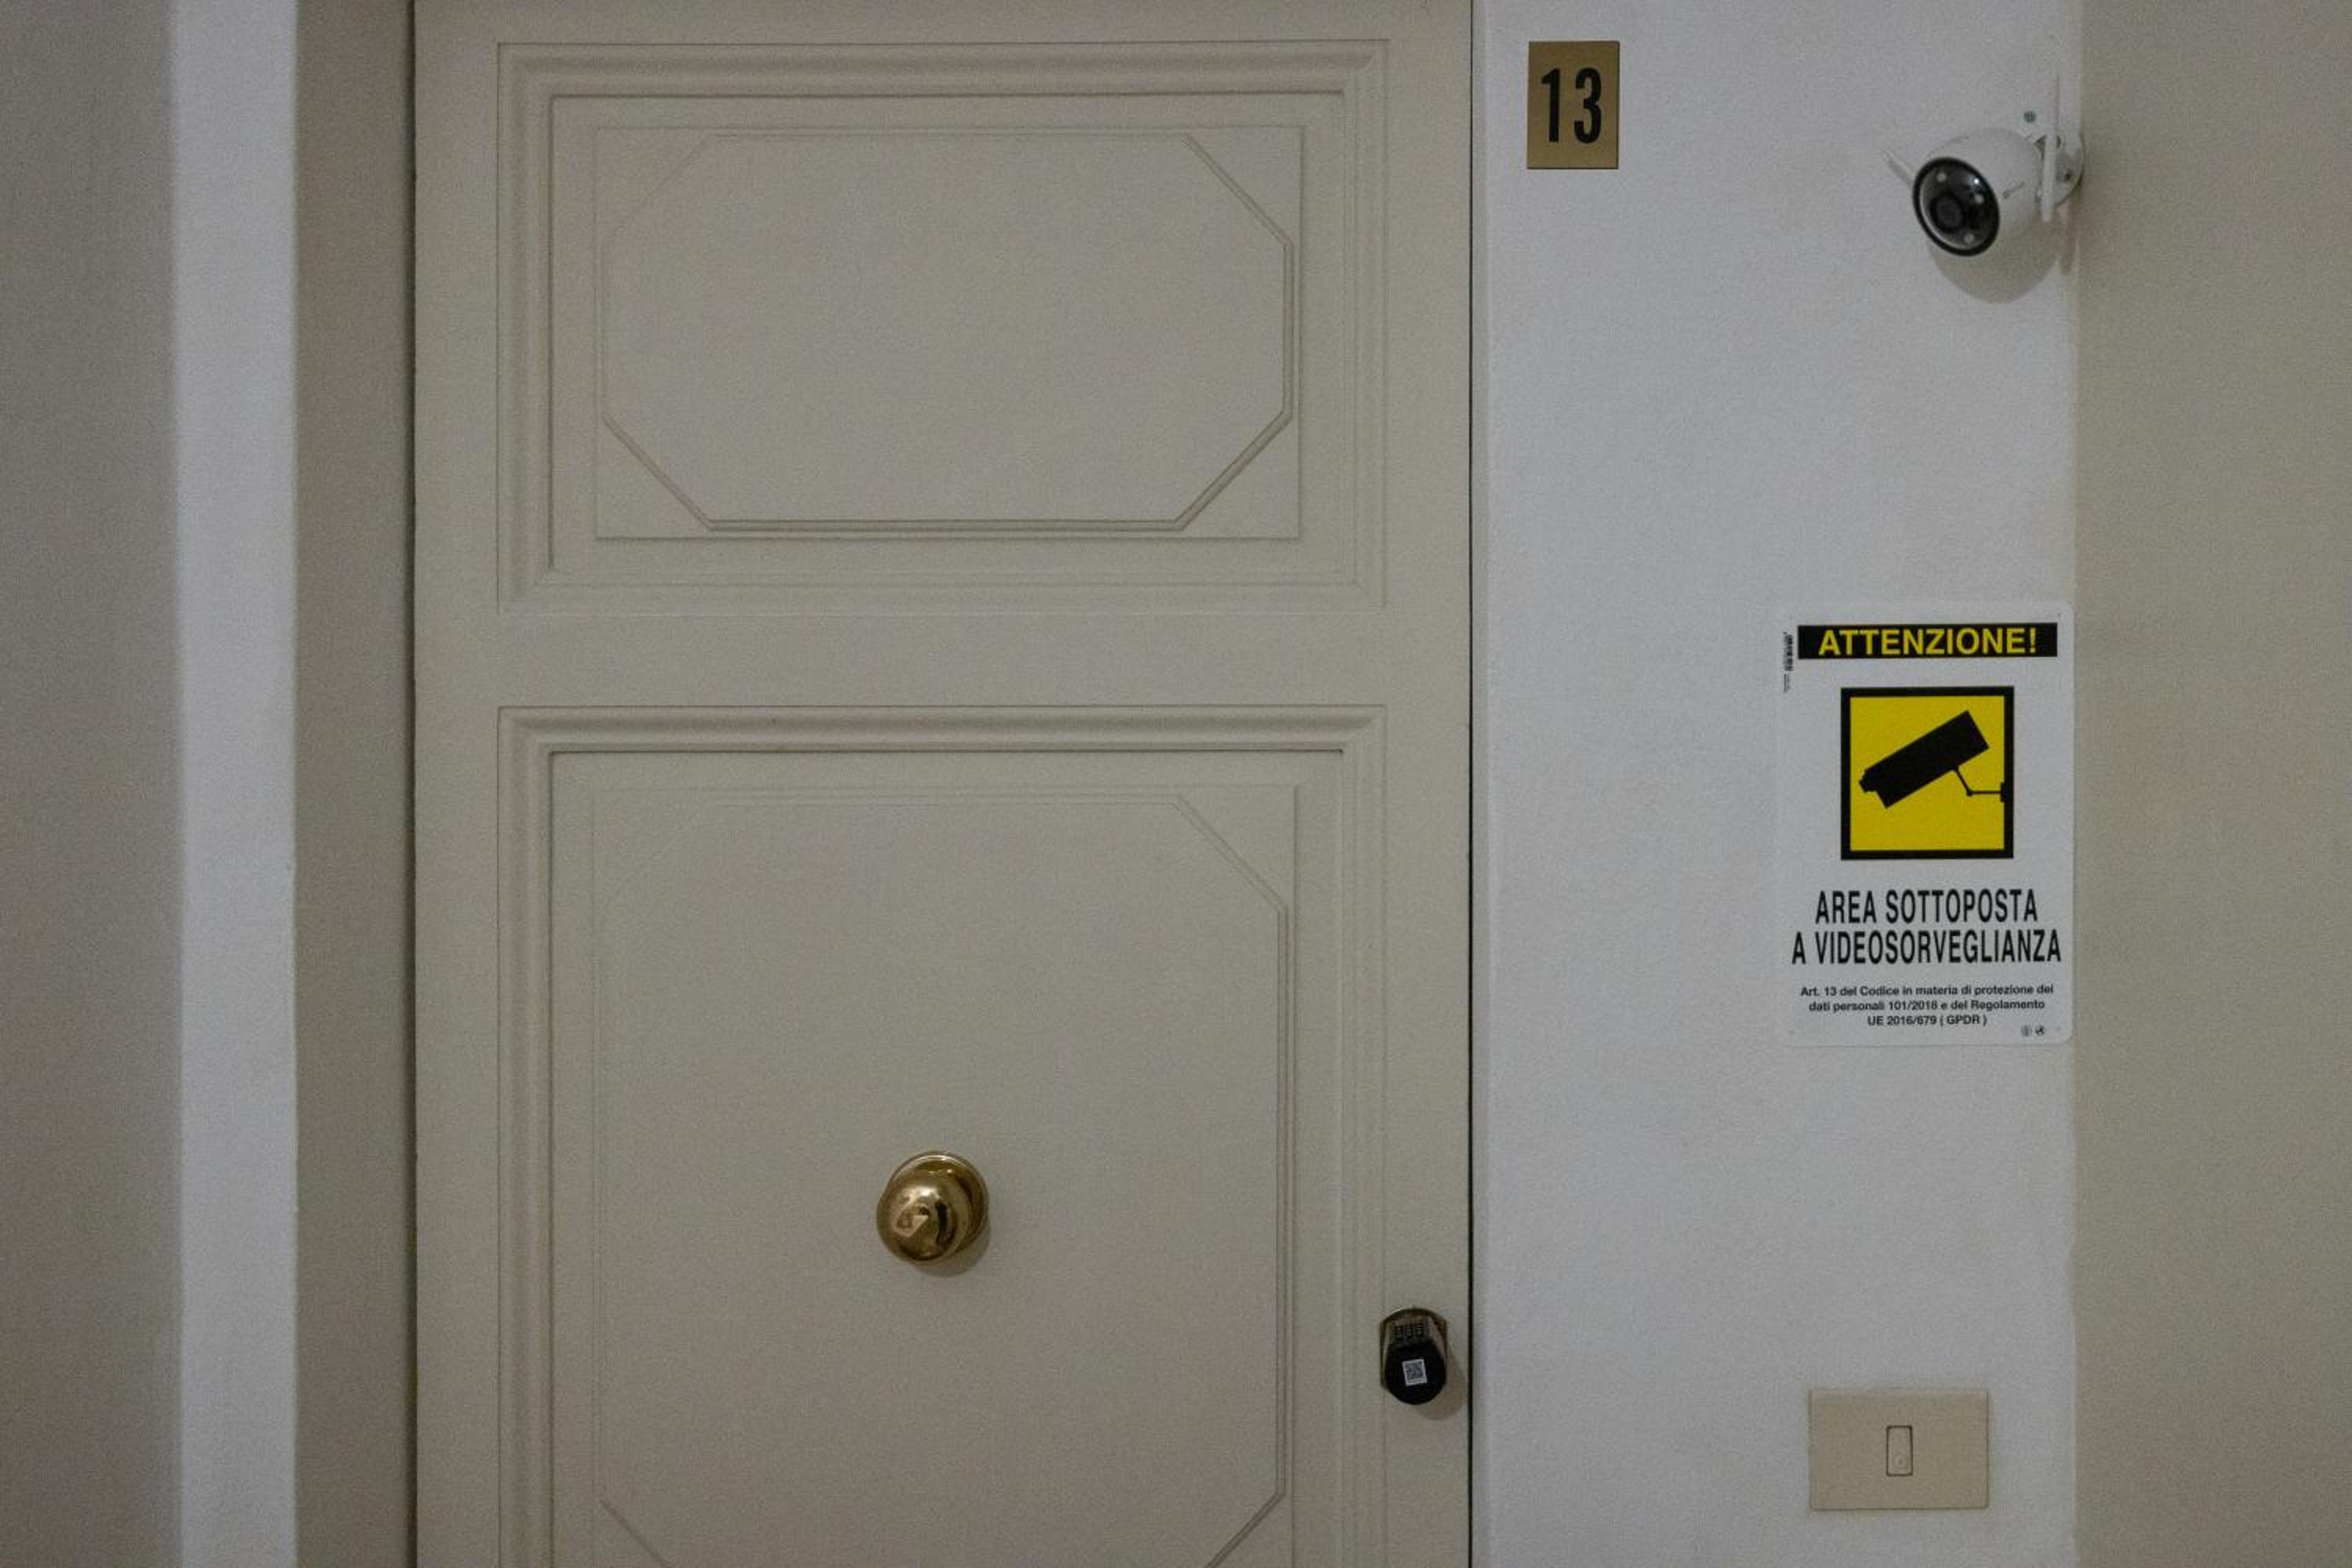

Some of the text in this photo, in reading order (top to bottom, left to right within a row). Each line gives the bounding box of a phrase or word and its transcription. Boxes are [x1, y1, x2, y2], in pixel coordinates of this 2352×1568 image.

[1541, 67, 1602, 143] 13
[1818, 628, 2038, 656] ATTENZIONE!
[1815, 888, 2038, 924] AREA SOTTOPOSTA
[1792, 929, 2062, 964] A VIDEOSORVEGLIANZA
[1801, 986, 1820, 996] Art.
[1824, 986, 1837, 996] 13
[1860, 985, 1900, 996] Codice
[1903, 985, 1912, 995] in
[1915, 985, 1958, 995] materia
[1962, 985, 1972, 995] di
[1975, 984, 2034, 996] protezione
[1809, 1001, 1830, 1011] dati
[1833, 1000, 1885, 1012] personali
[1889, 1000, 1937, 1011] 101/2018
[1971, 1000, 2045, 1011] Regolamento
[1867, 1016, 1883, 1025] UE
[1887, 1015, 1937, 1025] 2016/679
[1947, 1015, 1980, 1025] GPDR
